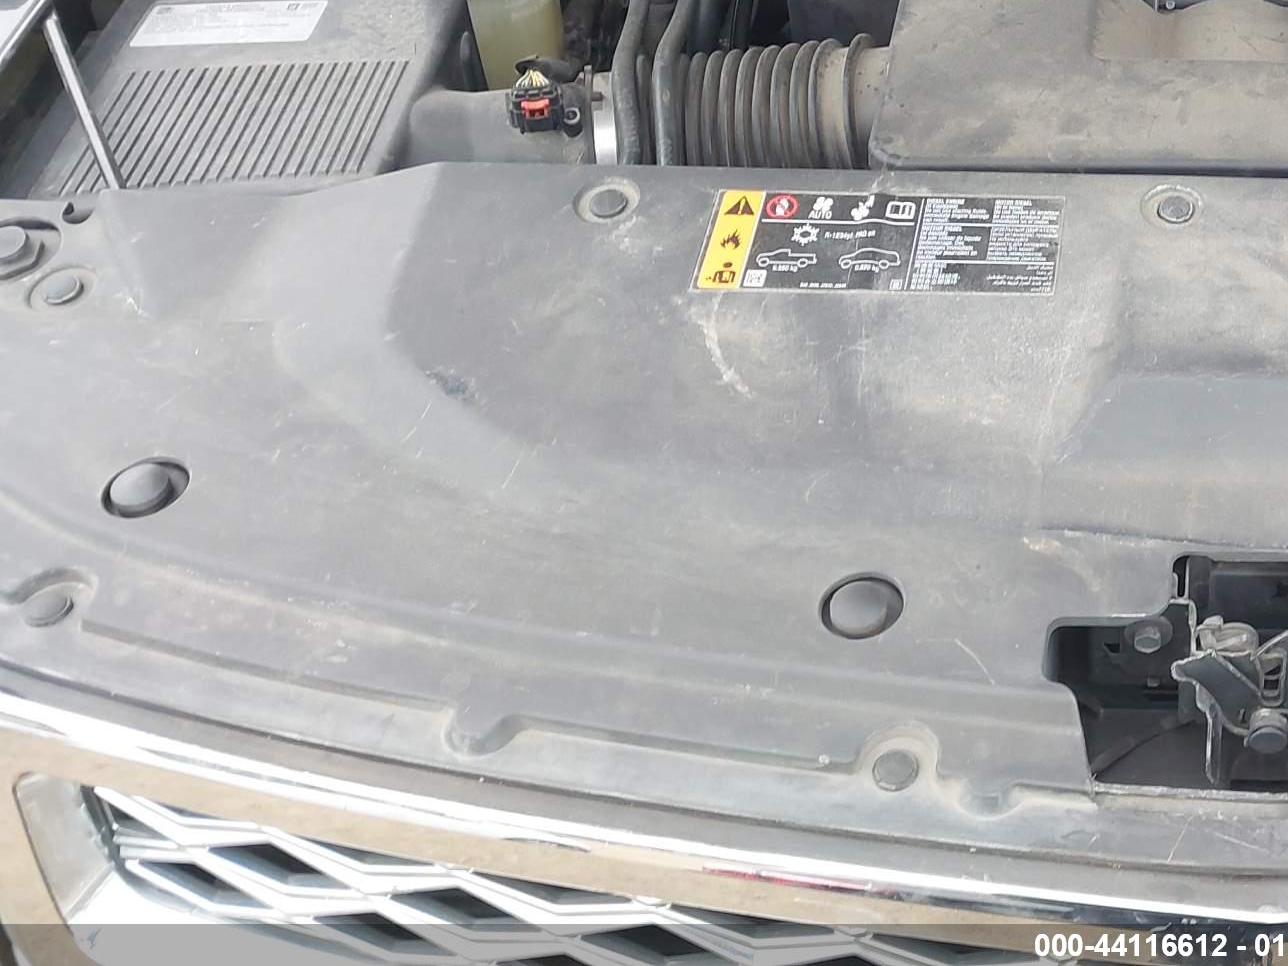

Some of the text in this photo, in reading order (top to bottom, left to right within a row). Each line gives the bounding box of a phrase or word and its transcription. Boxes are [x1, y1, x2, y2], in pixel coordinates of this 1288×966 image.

[807, 210, 833, 220] AUTO
[789, 265, 798, 273] kg
[872, 264, 880, 273] kg
